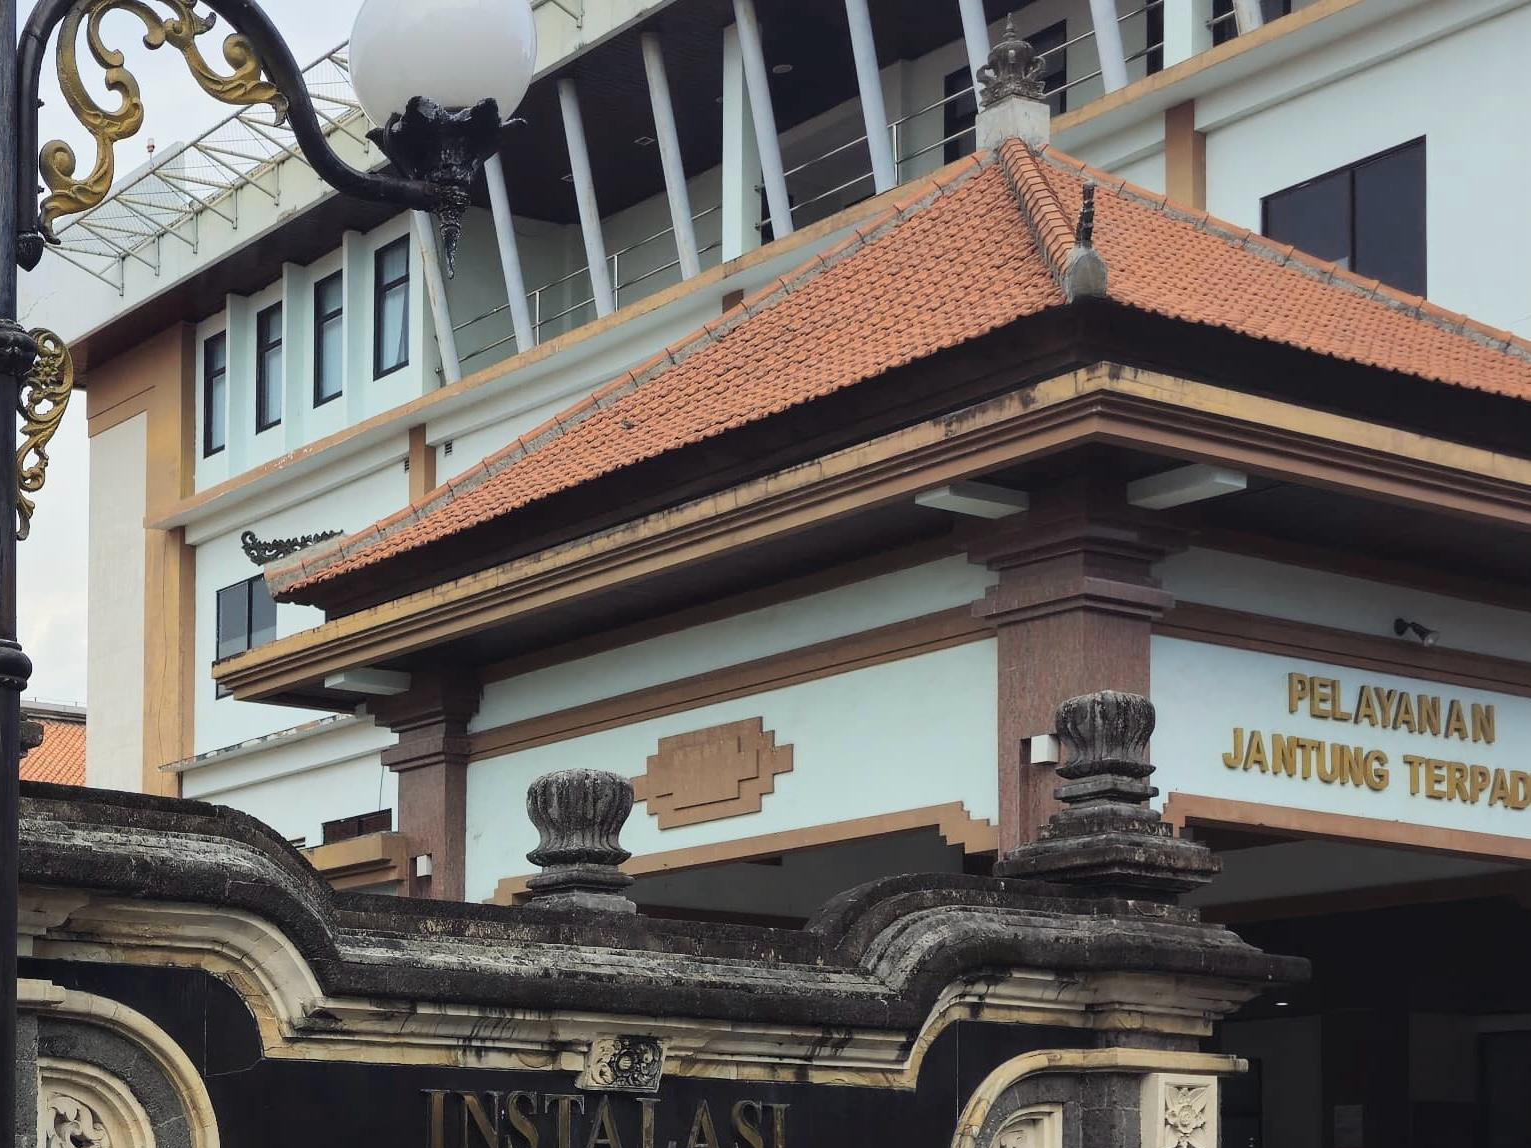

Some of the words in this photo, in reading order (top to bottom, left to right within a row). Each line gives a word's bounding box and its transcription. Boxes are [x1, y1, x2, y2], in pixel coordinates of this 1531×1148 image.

[1287, 671, 1496, 745] PELAYANAN
[1222, 727, 1390, 791] JANTUNG
[1402, 754, 1531, 810] TERPAD
